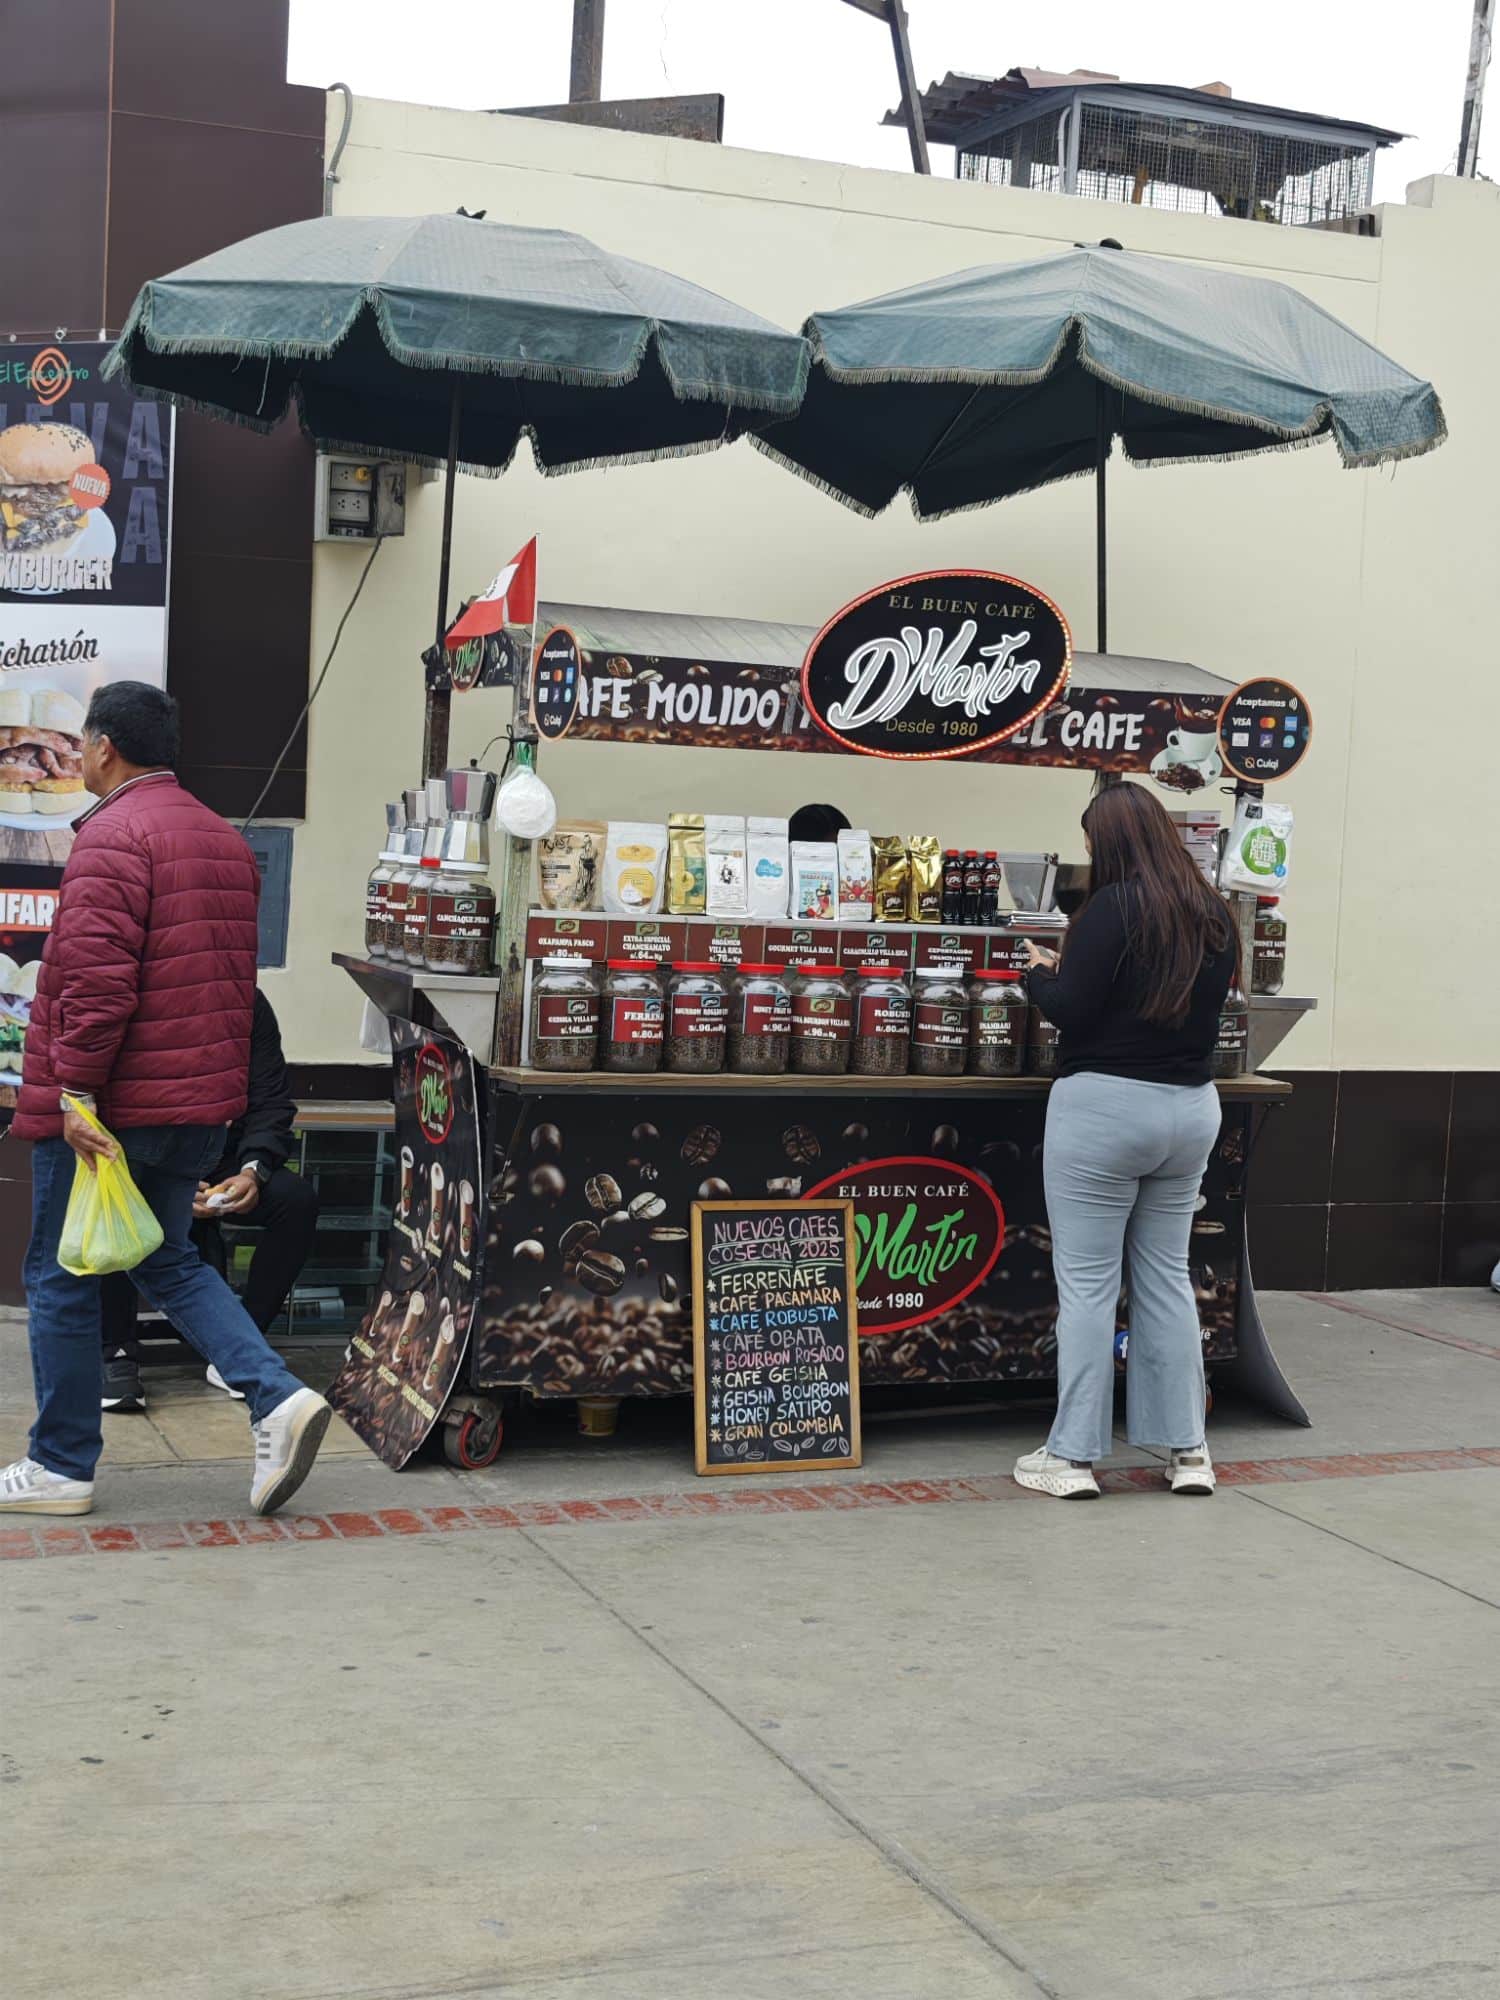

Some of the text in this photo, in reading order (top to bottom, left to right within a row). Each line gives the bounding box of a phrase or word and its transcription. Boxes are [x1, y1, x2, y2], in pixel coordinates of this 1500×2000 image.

[72, 471, 108, 497] NUEVA
[889, 595, 1036, 619] EL BUEN CAFÉ
[647, 681, 780, 727] MOLIDO
[1236, 696, 1286, 709] Aceptamos
[885, 718, 979, 737] Desde 1980
[1060, 710, 1145, 751] CAFE
[1232, 717, 1252, 727] VISA
[1256, 758, 1279, 771] Culqi
[709, 946, 742, 955] VILLA RICA
[799, 945, 818, 954] VILLA
[838, 1182, 969, 1198] EL BUEN CAFÉ
[713, 1215, 840, 1244] NUEVOS CAFES
[708, 1241, 840, 1265] COSECHA 2025
[719, 1287, 842, 1314] CAFÉ PACAMARA
[886, 1293, 924, 1309] 1980
[765, 1306, 839, 1327] ROBUSTA
[723, 1326, 826, 1353] CAFÉ OBATA
[725, 1345, 845, 1371] BOURBON ROSADO
[724, 1363, 829, 1389] CAFÉ GEISHA
[723, 1381, 850, 1410] GEISHA BOURBON
[723, 1400, 832, 1427] HONEY SATIPO
[725, 1414, 844, 1442] GRAN COLOMBIA
